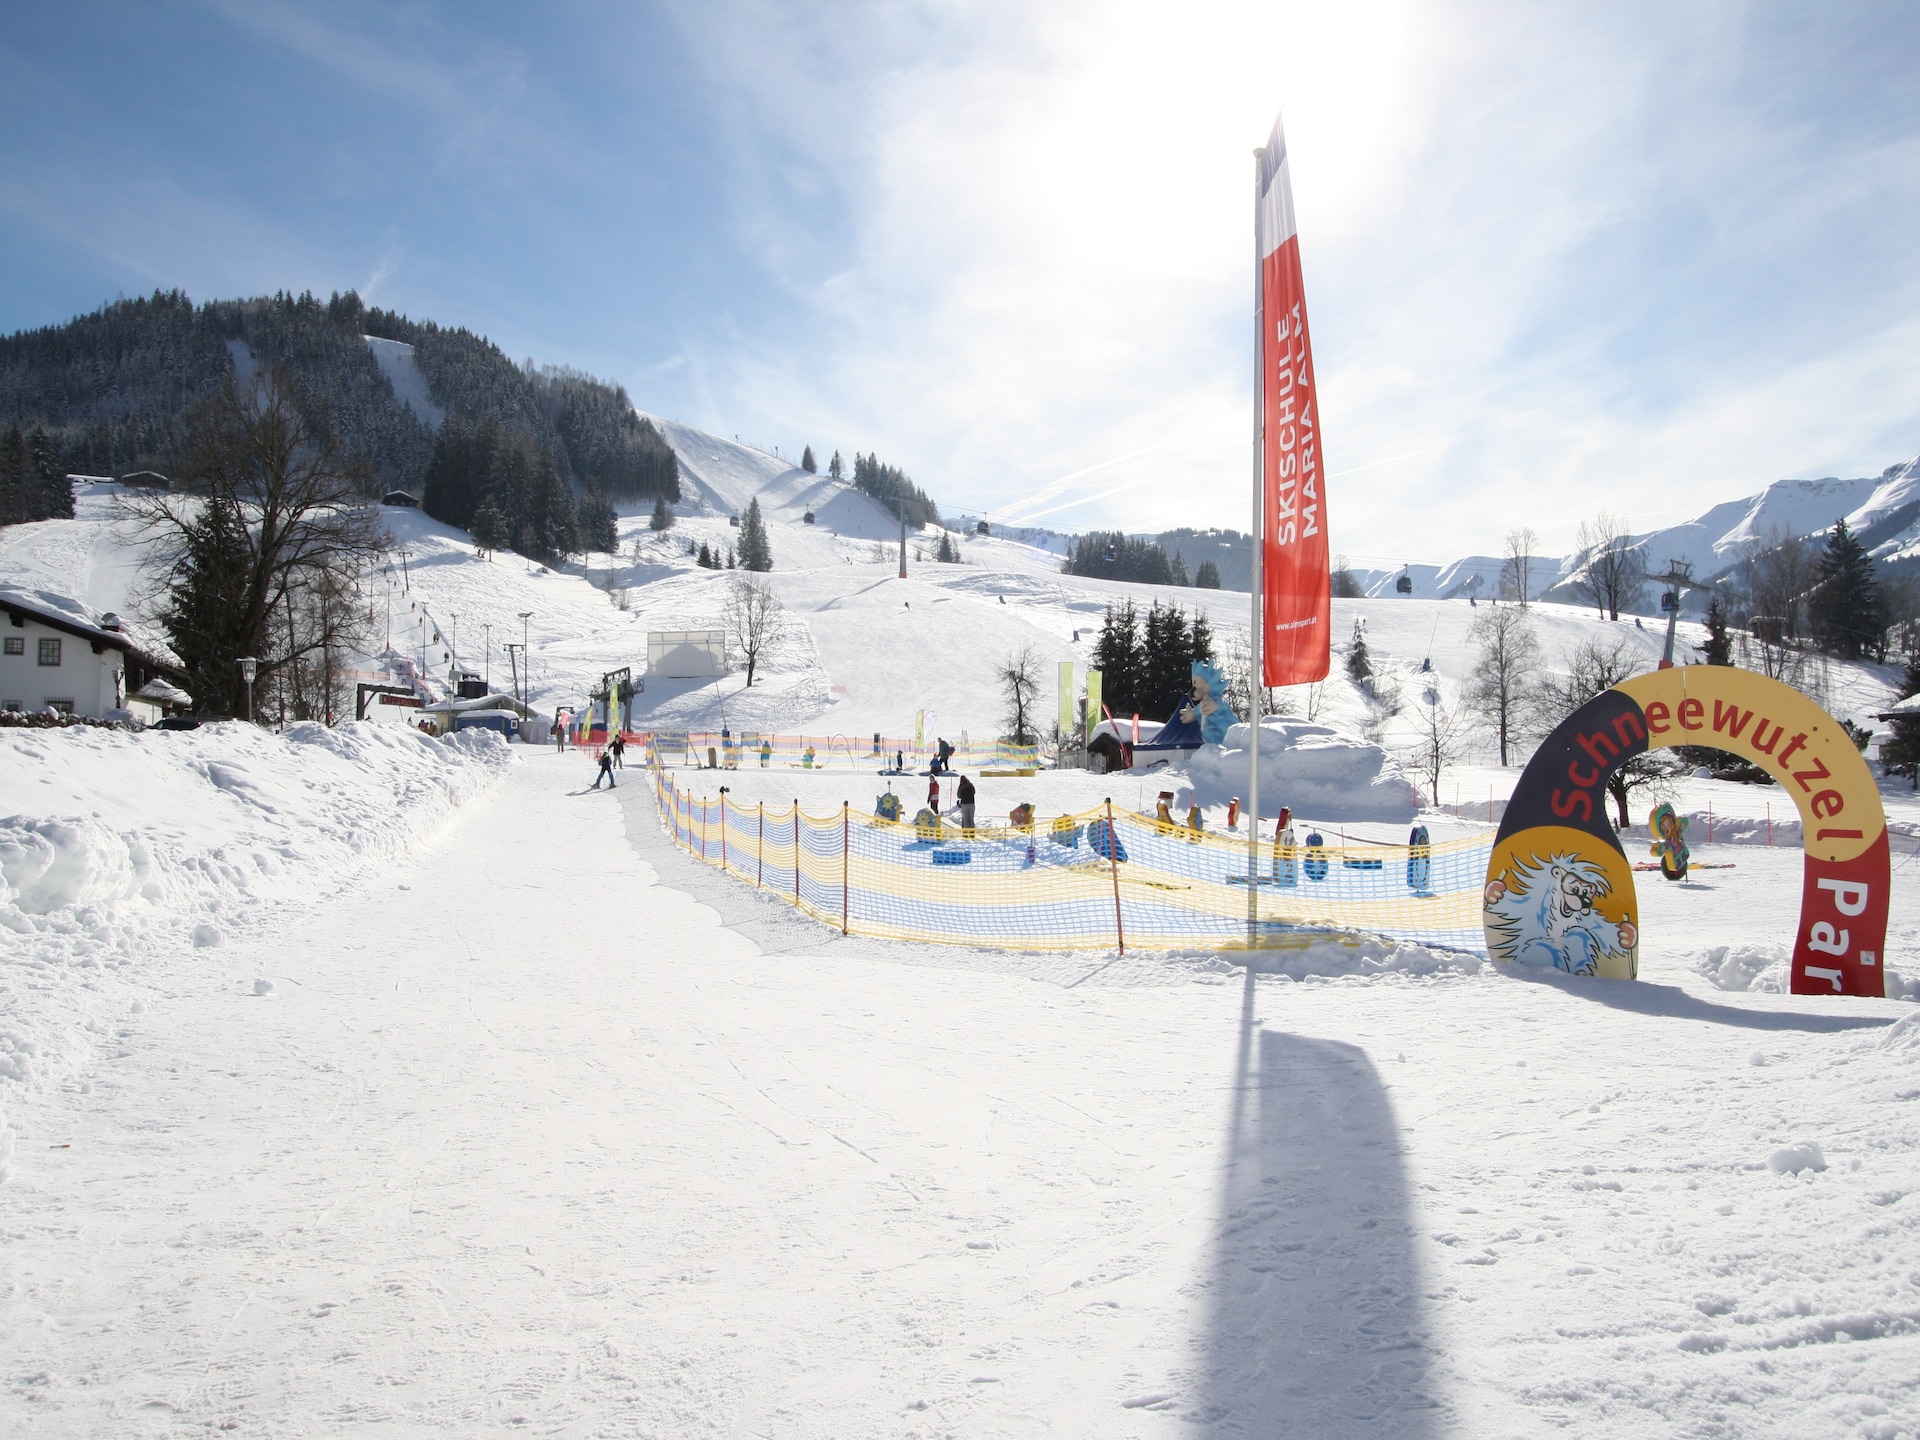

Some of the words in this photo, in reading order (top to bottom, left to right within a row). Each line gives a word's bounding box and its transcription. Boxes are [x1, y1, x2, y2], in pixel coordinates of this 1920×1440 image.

[1292, 300, 1308, 387] ALM
[1277, 313, 1296, 545] SKISCHULE
[1300, 400, 1318, 538] MARIA
[1551, 698, 1863, 842] Schneewutzel
